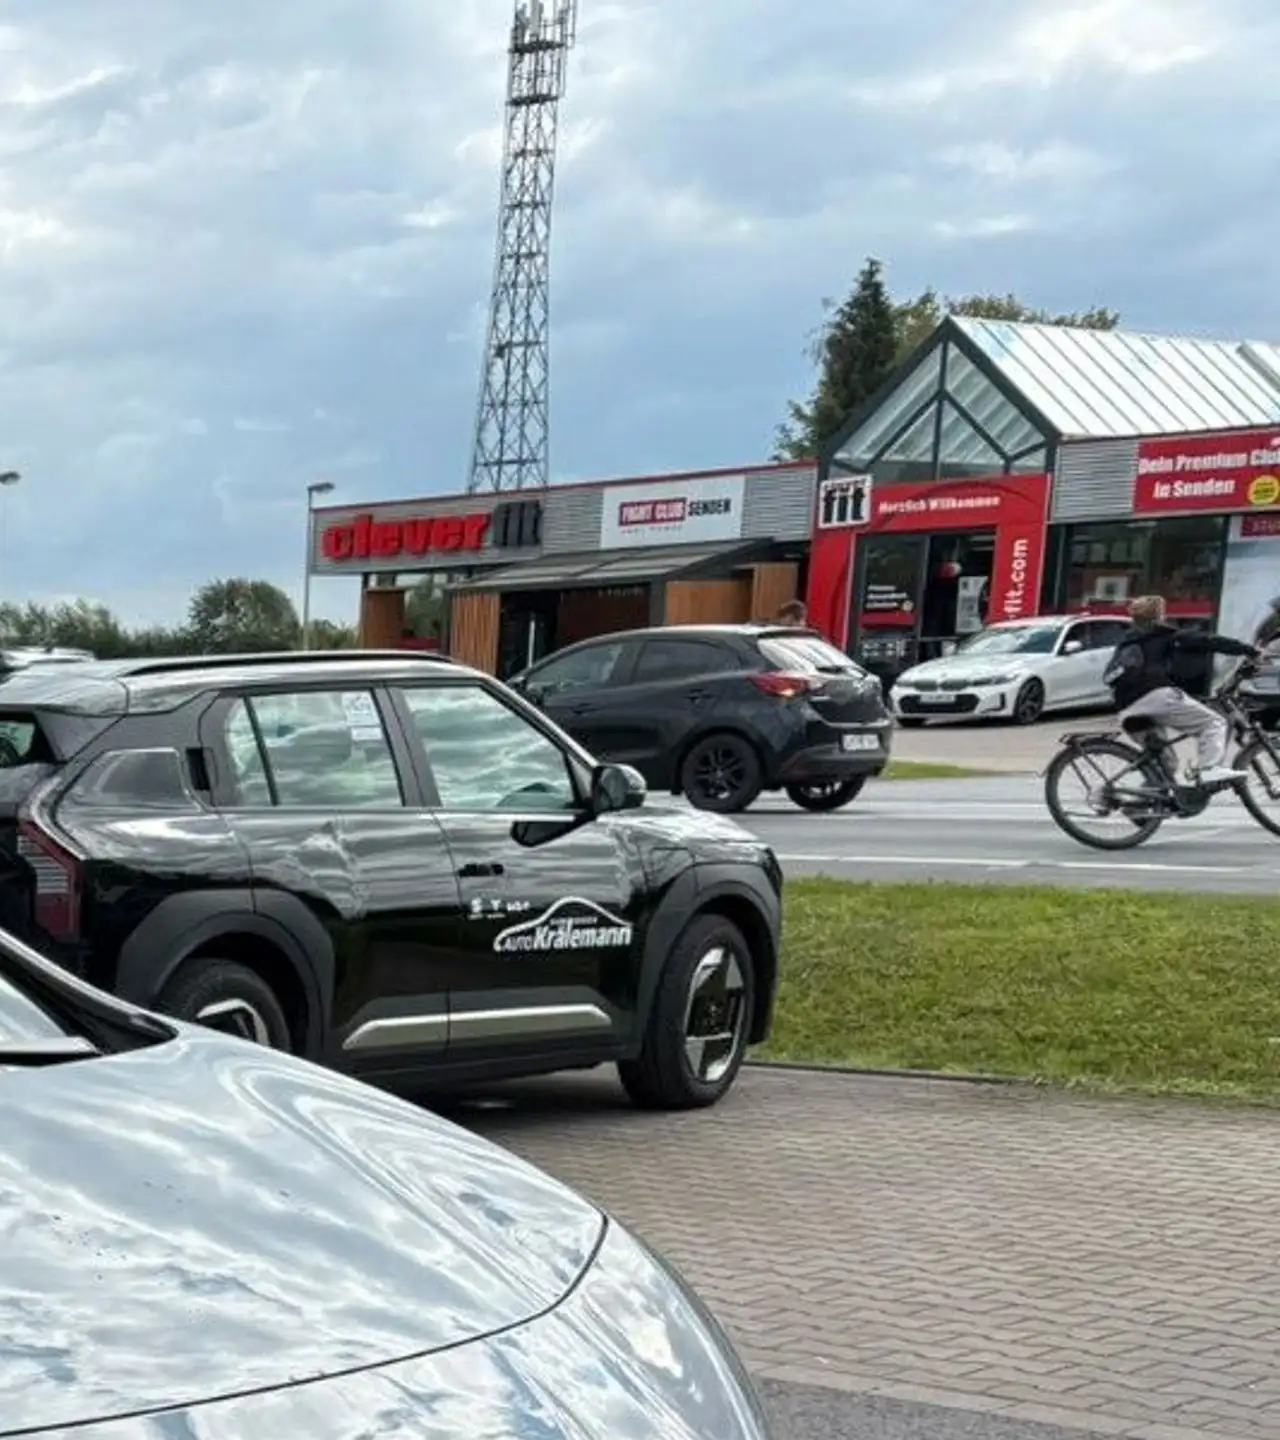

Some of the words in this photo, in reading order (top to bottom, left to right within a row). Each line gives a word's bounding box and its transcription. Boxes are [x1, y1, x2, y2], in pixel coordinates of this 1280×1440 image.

[1138, 456, 1173, 475] Dein
[1175, 452, 1248, 471] Premium
[1250, 448, 1280, 466] Clu
[1172, 478, 1235, 497] Senden
[928, 496, 1000, 512] Willkommen
[320, 513, 491, 561] clever
